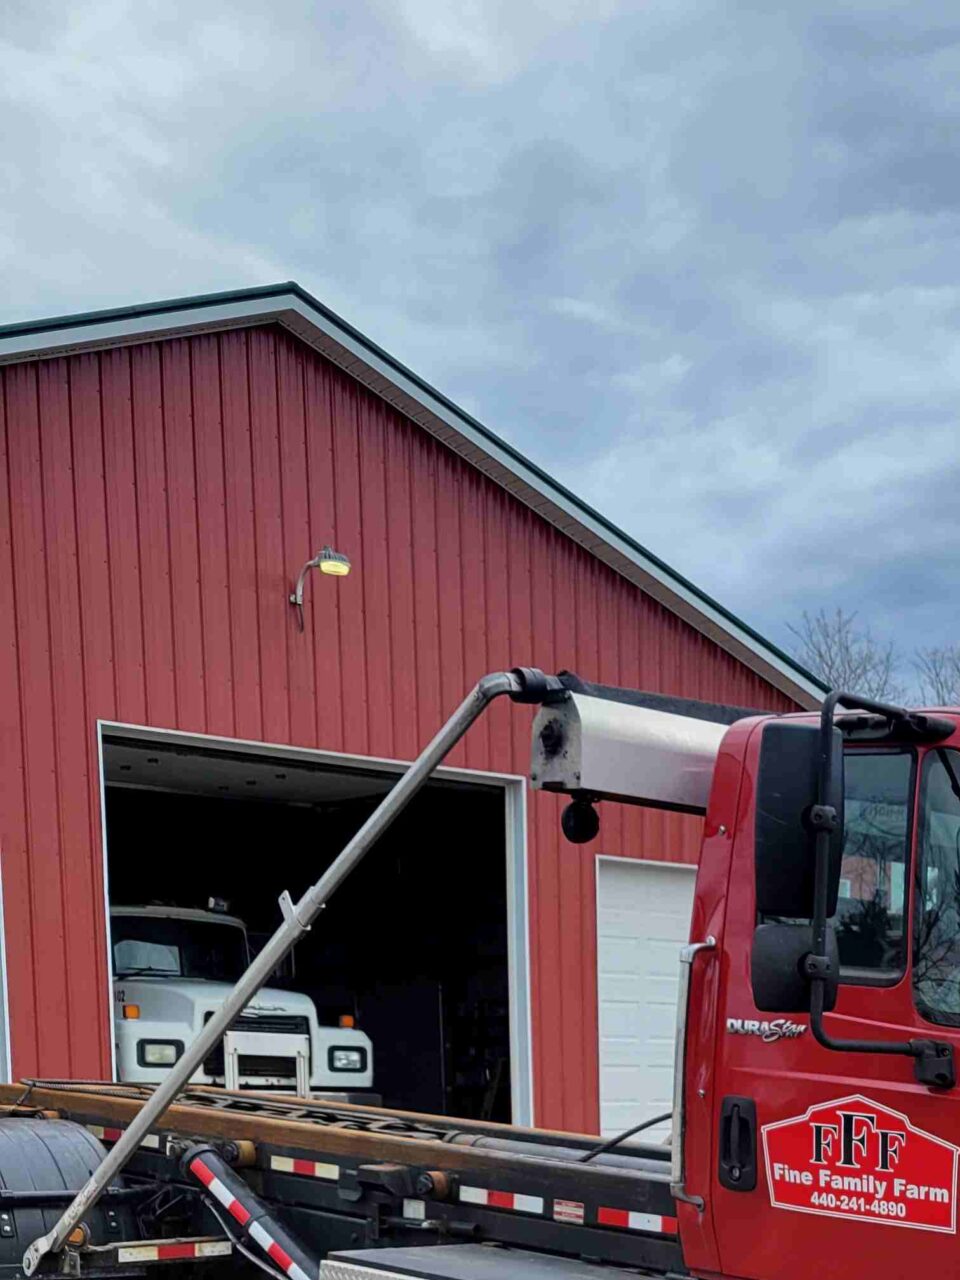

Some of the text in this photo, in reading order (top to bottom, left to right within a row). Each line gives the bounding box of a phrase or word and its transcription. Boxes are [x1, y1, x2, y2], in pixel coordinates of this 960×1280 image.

[773, 1162, 949, 1203] Fine Family Farm
[810, 1191, 906, 1217] 440-241-4890
